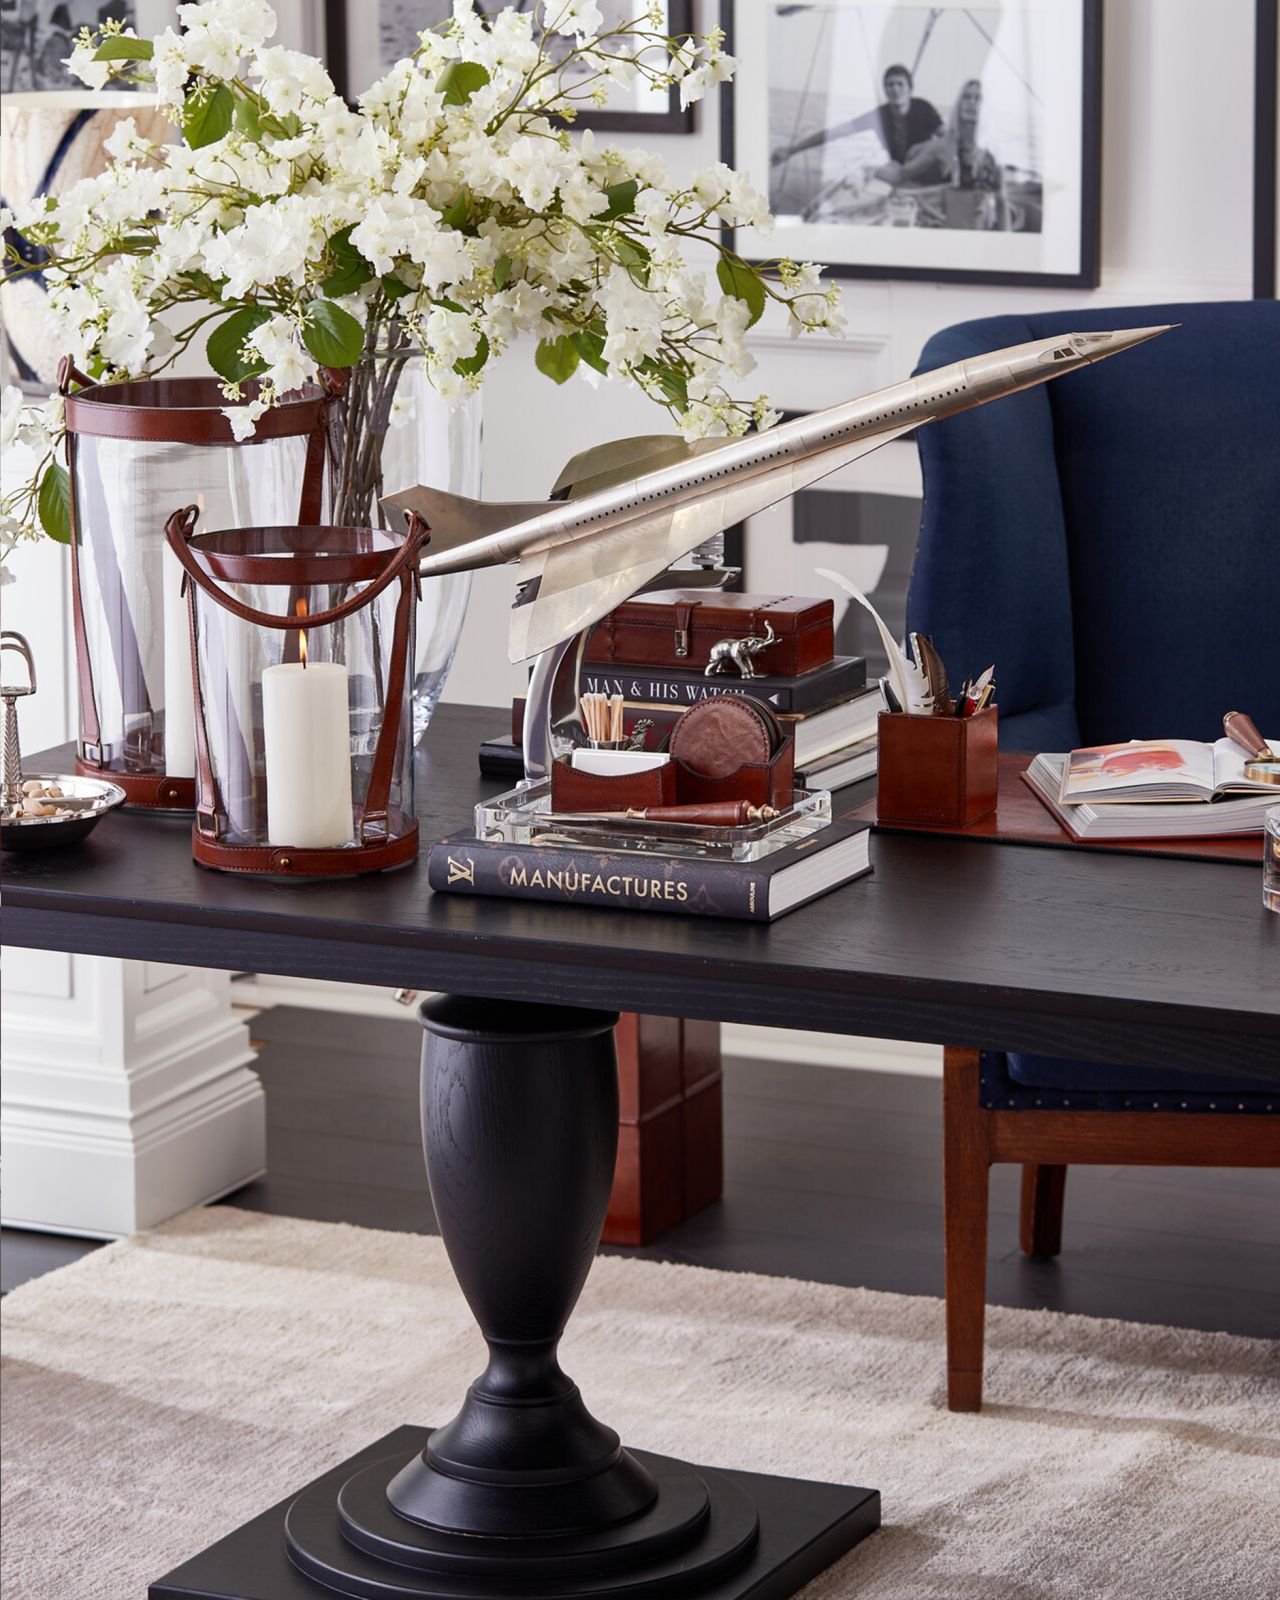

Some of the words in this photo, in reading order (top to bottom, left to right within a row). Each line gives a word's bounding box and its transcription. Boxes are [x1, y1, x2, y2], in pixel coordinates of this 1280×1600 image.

[587, 677, 624, 694] MAN
[630, 680, 642, 697] &
[650, 682, 679, 700] HIS
[510, 867, 689, 901] MANUFACTURES
